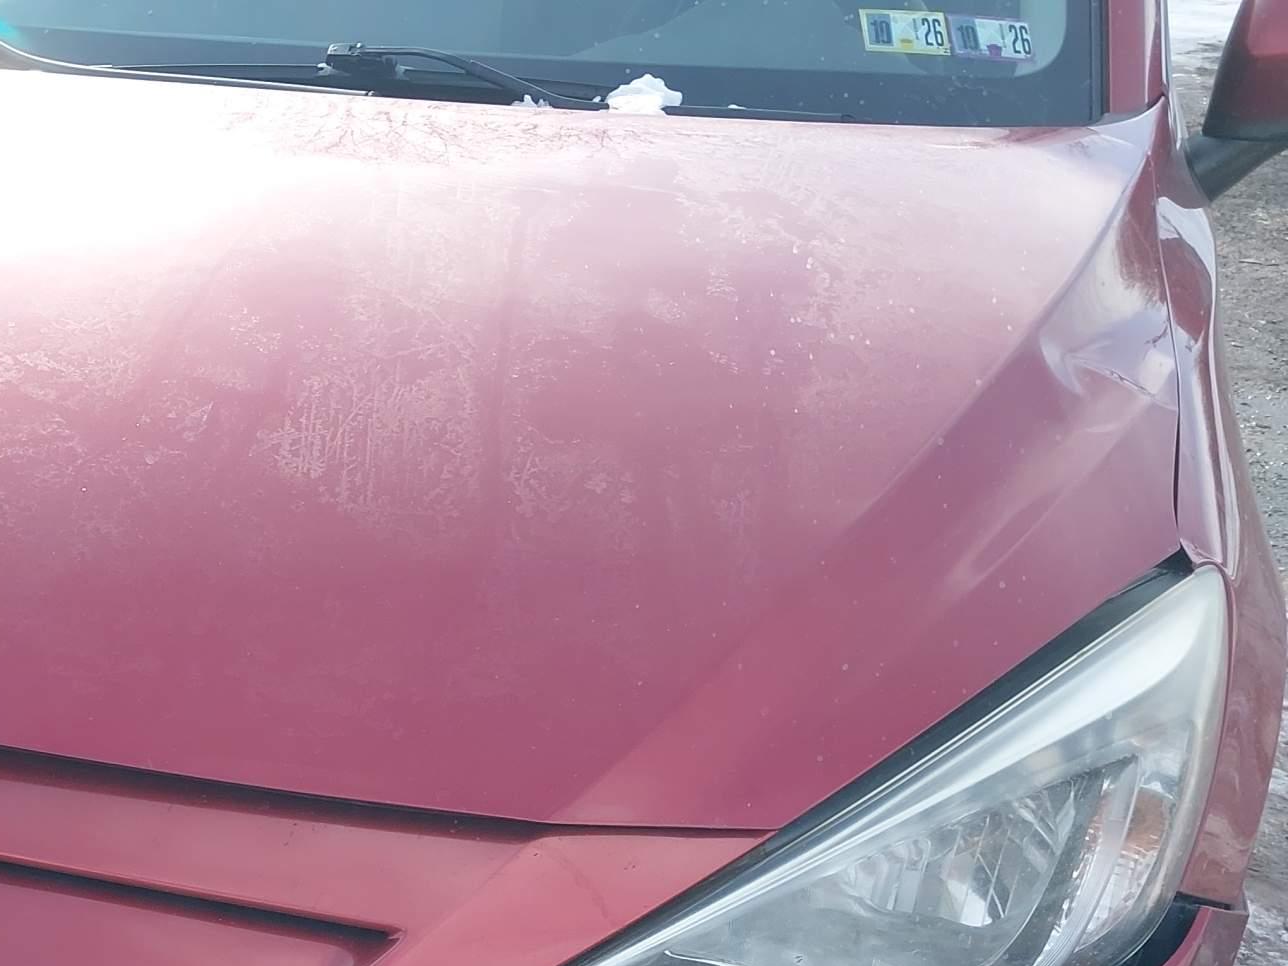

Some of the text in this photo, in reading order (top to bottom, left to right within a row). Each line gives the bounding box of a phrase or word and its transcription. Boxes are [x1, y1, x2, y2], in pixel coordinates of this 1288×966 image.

[870, 19, 892, 44] 10
[921, 17, 944, 47] 26
[957, 25, 980, 50] 10
[1009, 24, 1031, 55] 26
